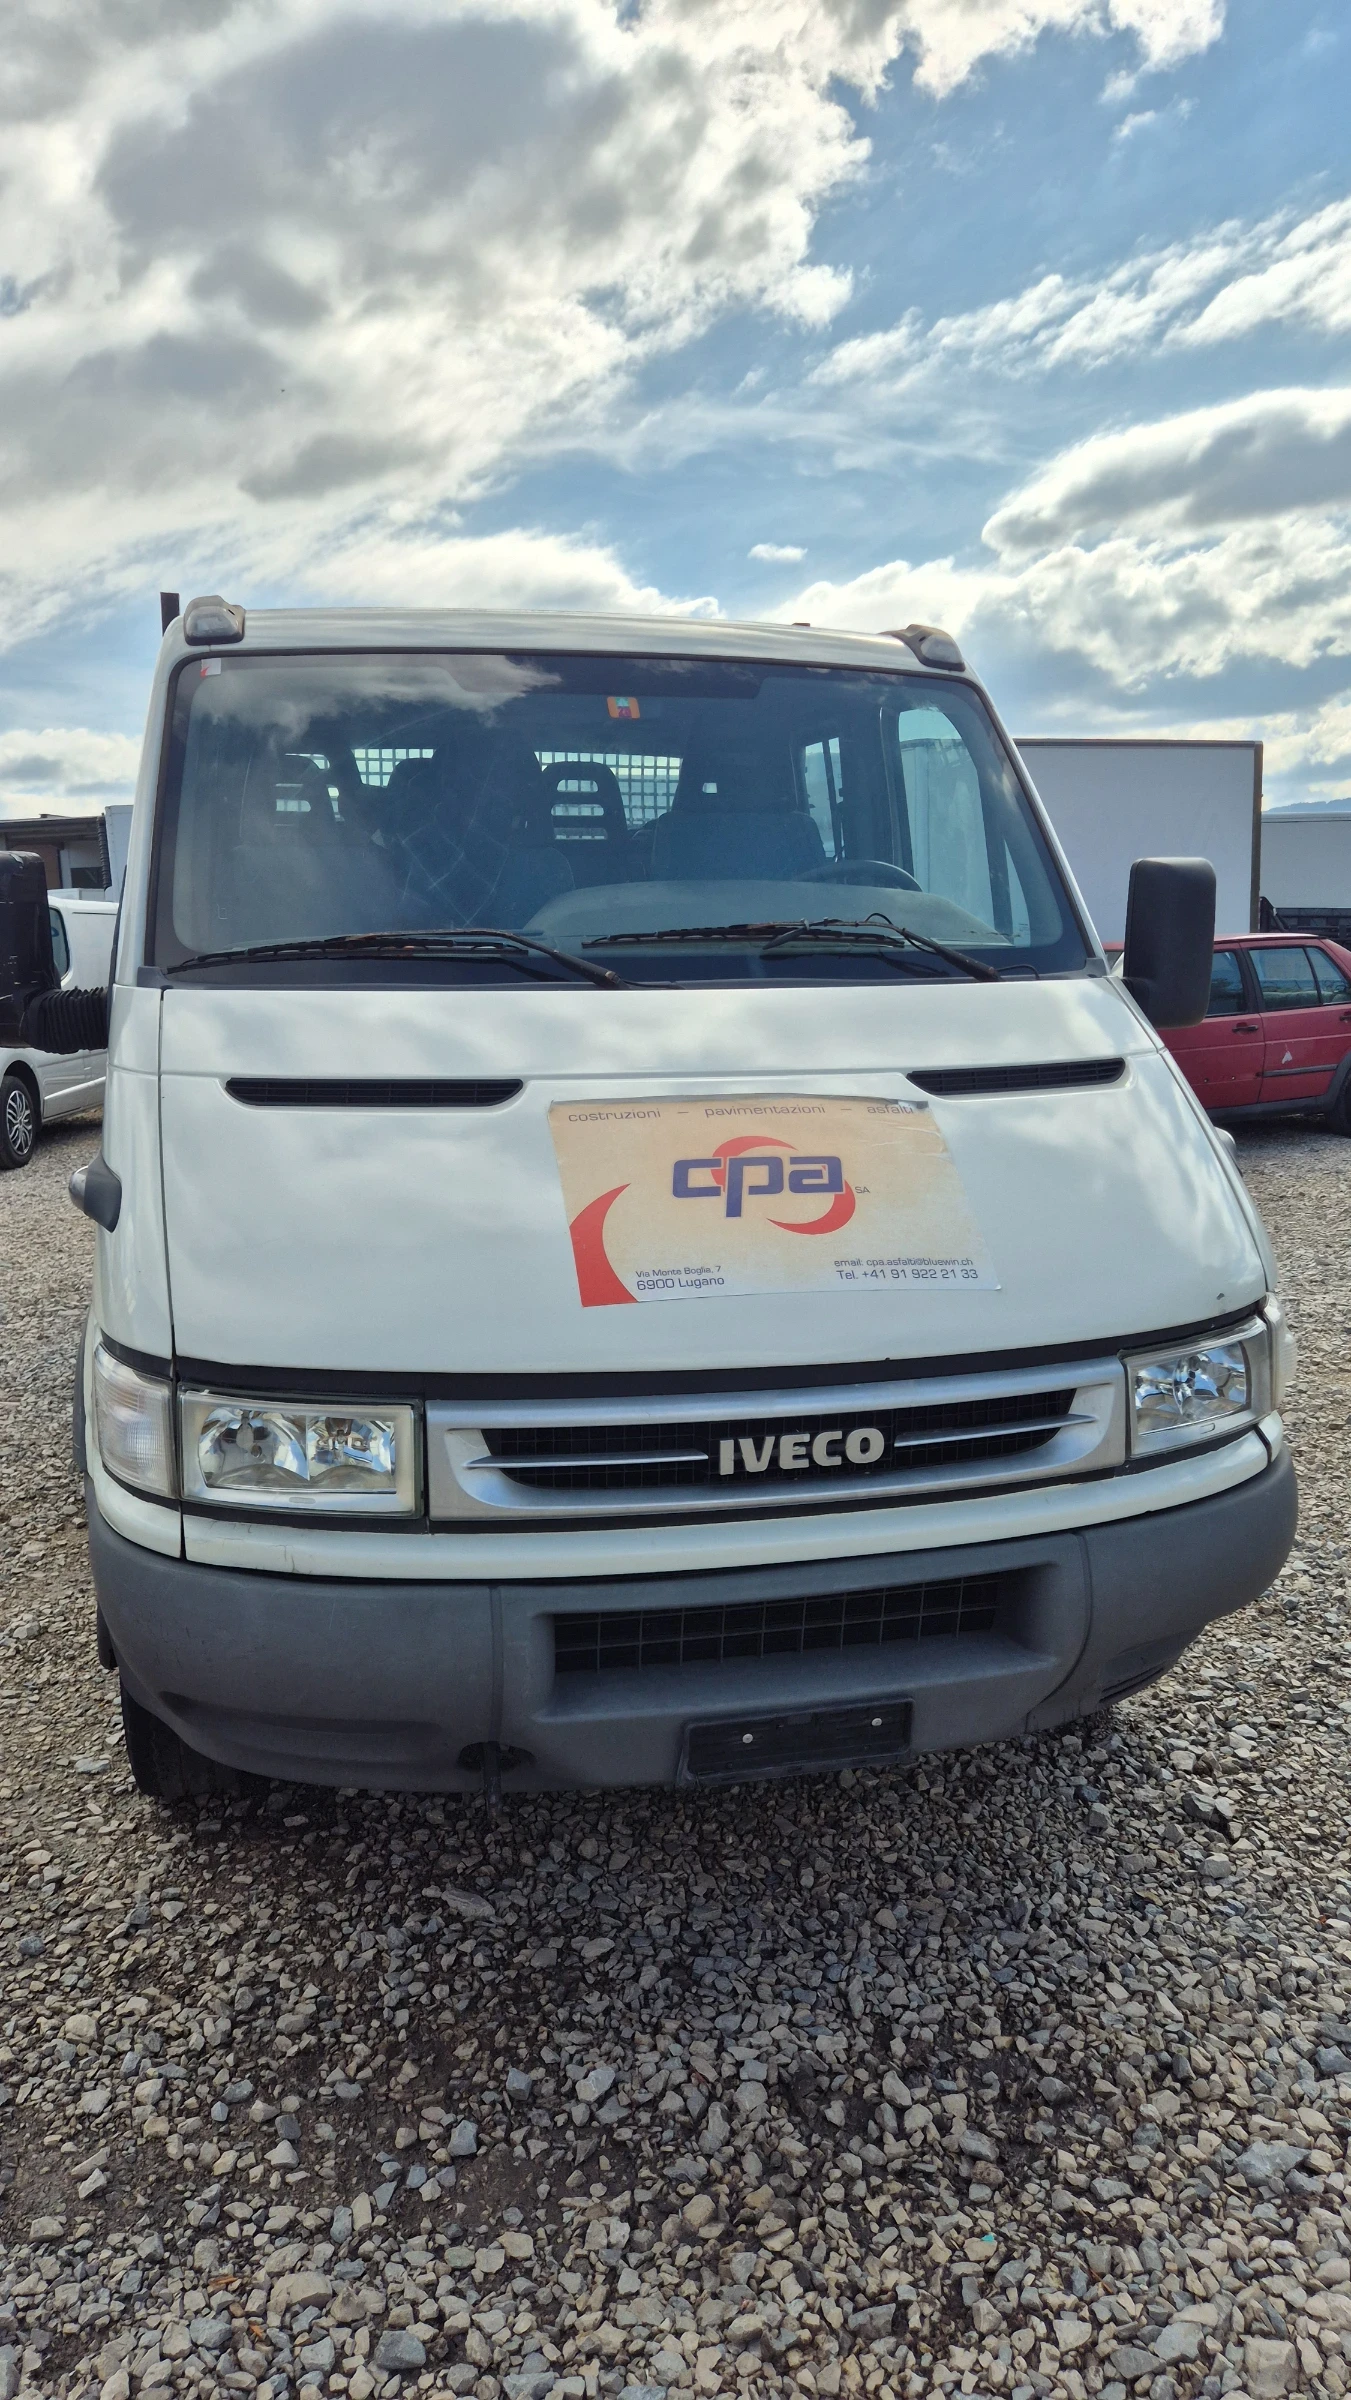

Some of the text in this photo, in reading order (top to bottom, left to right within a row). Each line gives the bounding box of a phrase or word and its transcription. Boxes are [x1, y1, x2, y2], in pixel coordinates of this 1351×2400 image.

[567, 1107, 662, 1123] costruzioni
[704, 1103, 827, 1119] pavimentazioni
[866, 1103, 915, 1115] asfalti
[672, 1155, 844, 1218] cpa
[854, 1185, 871, 1195] SA
[833, 1257, 974, 1268] email: cpa.asfalti@bluewin.ch
[635, 1265, 721, 1278] Via Monte Boglia, 7
[836, 1268, 979, 1280] Tel. +41 91 922 21 33
[636, 1277, 725, 1291] 6900 Lugano
[719, 1426, 885, 1477] IVECO
